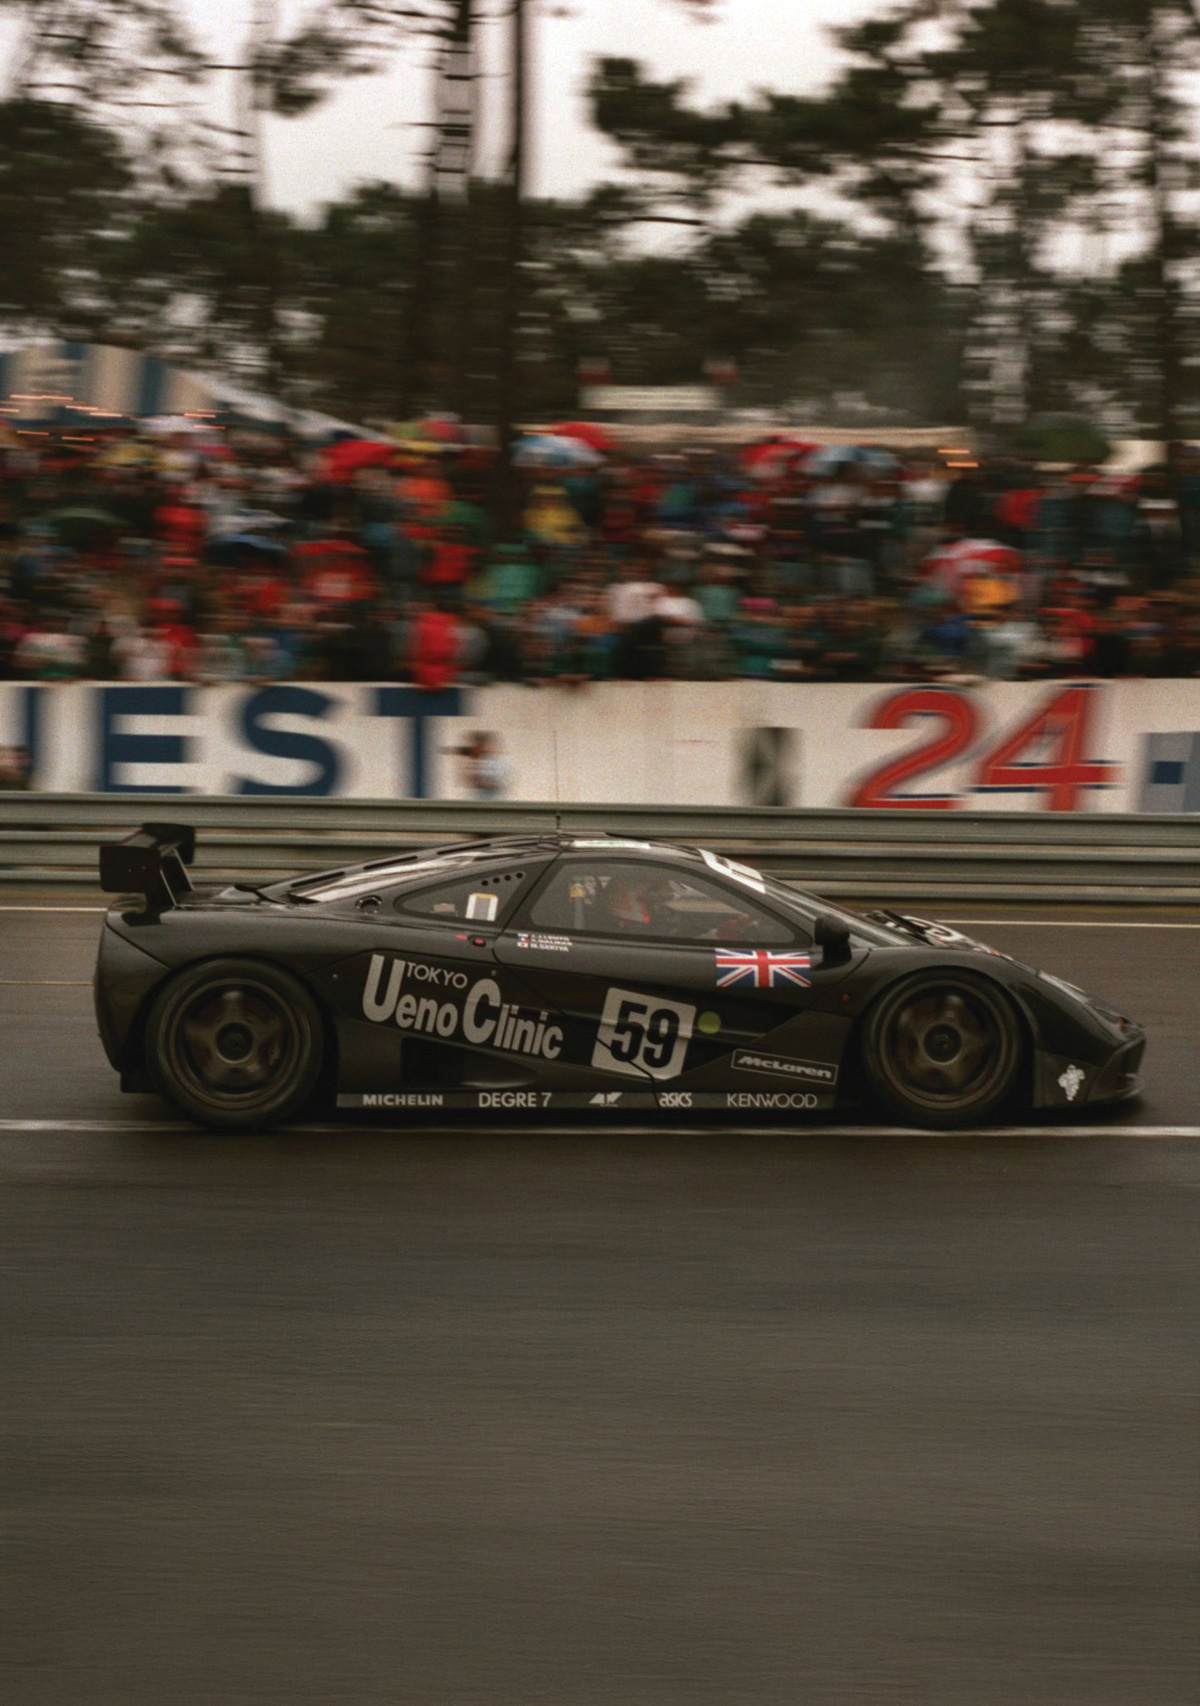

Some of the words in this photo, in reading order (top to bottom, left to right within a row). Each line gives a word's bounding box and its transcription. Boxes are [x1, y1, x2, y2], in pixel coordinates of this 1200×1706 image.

[838, 684, 1124, 811] 24
[405, 961, 468, 989] TOKYO
[362, 954, 459, 1037] Ueno
[462, 978, 564, 1059] Clinic
[610, 1000, 680, 1068] 59
[737, 1055, 832, 1079] McLaren
[362, 1094, 444, 1106] MICHELIN
[478, 1092, 537, 1108] DEGRE
[540, 1092, 553, 1108] 7
[727, 1093, 818, 1108] KENWOOD
